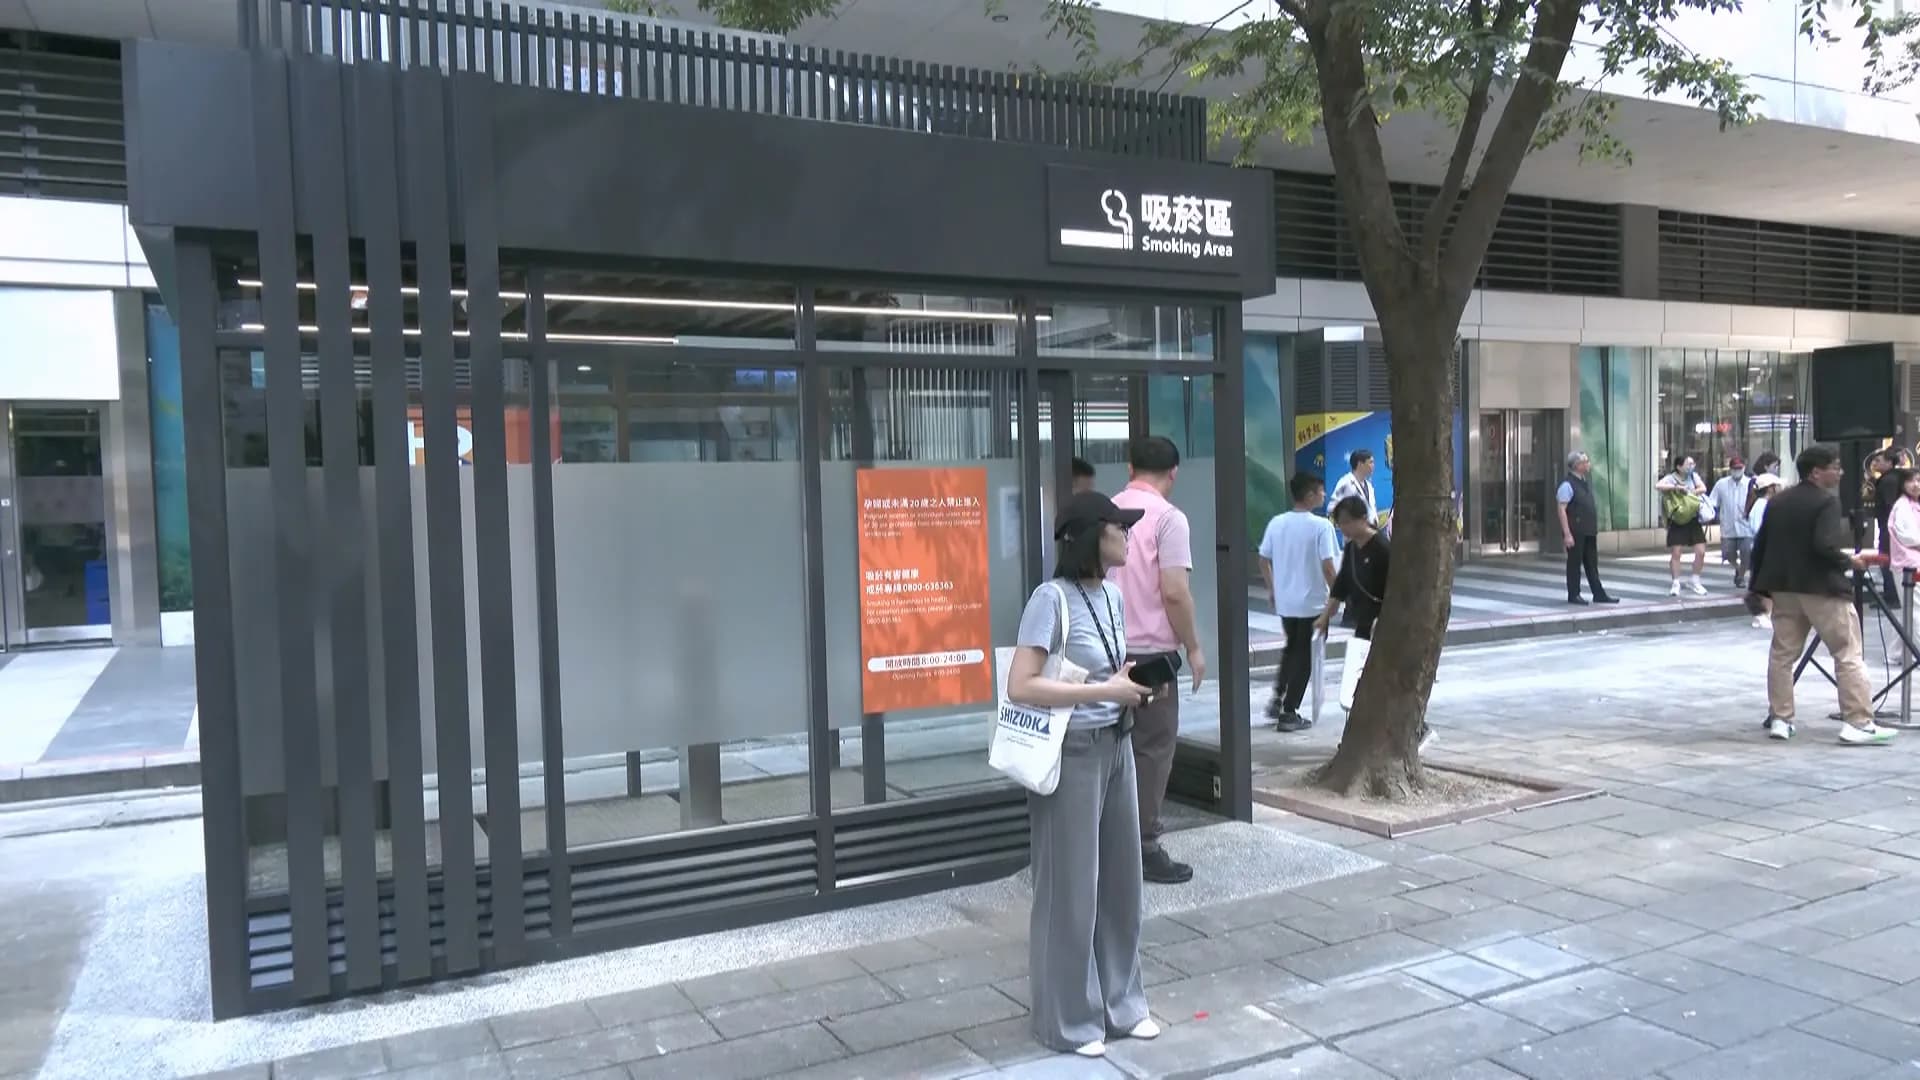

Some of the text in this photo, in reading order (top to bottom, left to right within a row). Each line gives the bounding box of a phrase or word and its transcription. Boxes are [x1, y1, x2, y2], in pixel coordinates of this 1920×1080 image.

[1141, 194, 1234, 237] 吸菸區
[1142, 235, 1233, 258] Smoking Area
